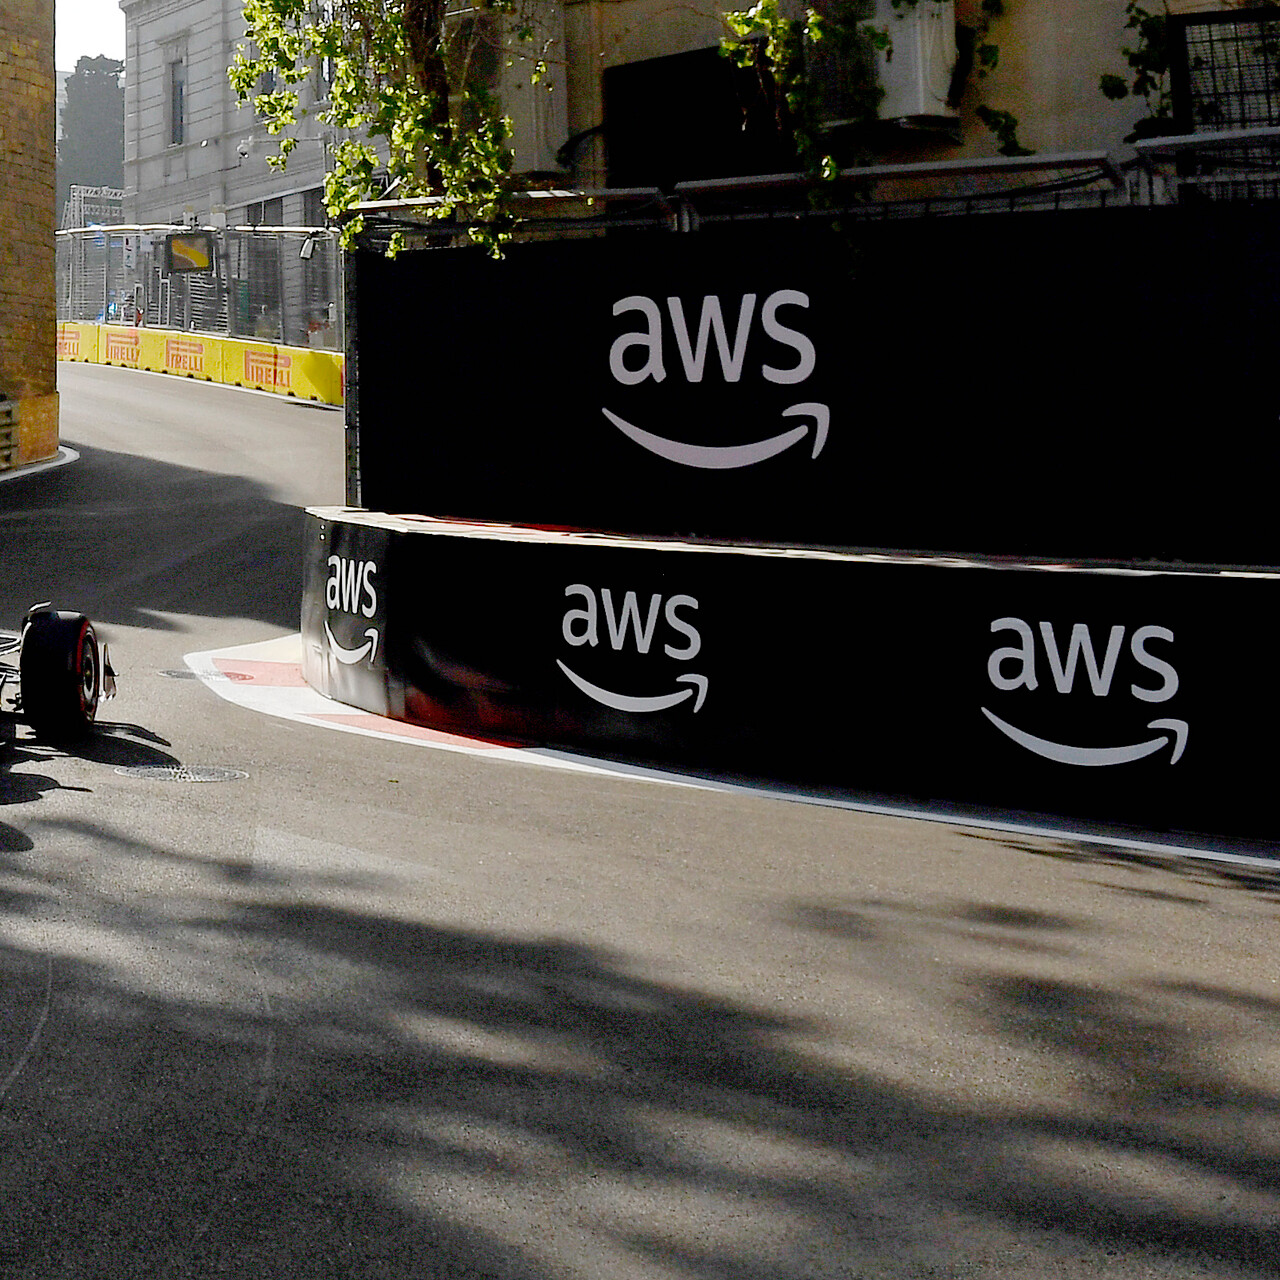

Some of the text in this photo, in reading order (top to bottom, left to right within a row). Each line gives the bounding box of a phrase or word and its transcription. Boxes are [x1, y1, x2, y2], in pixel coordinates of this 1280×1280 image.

[165, 338, 203, 372] PIRELLI
[244, 349, 292, 388] PIRELLI
[609, 290, 816, 385] aws
[326, 554, 377, 618] aws
[562, 583, 702, 661] aws
[987, 617, 1179, 703] aws
